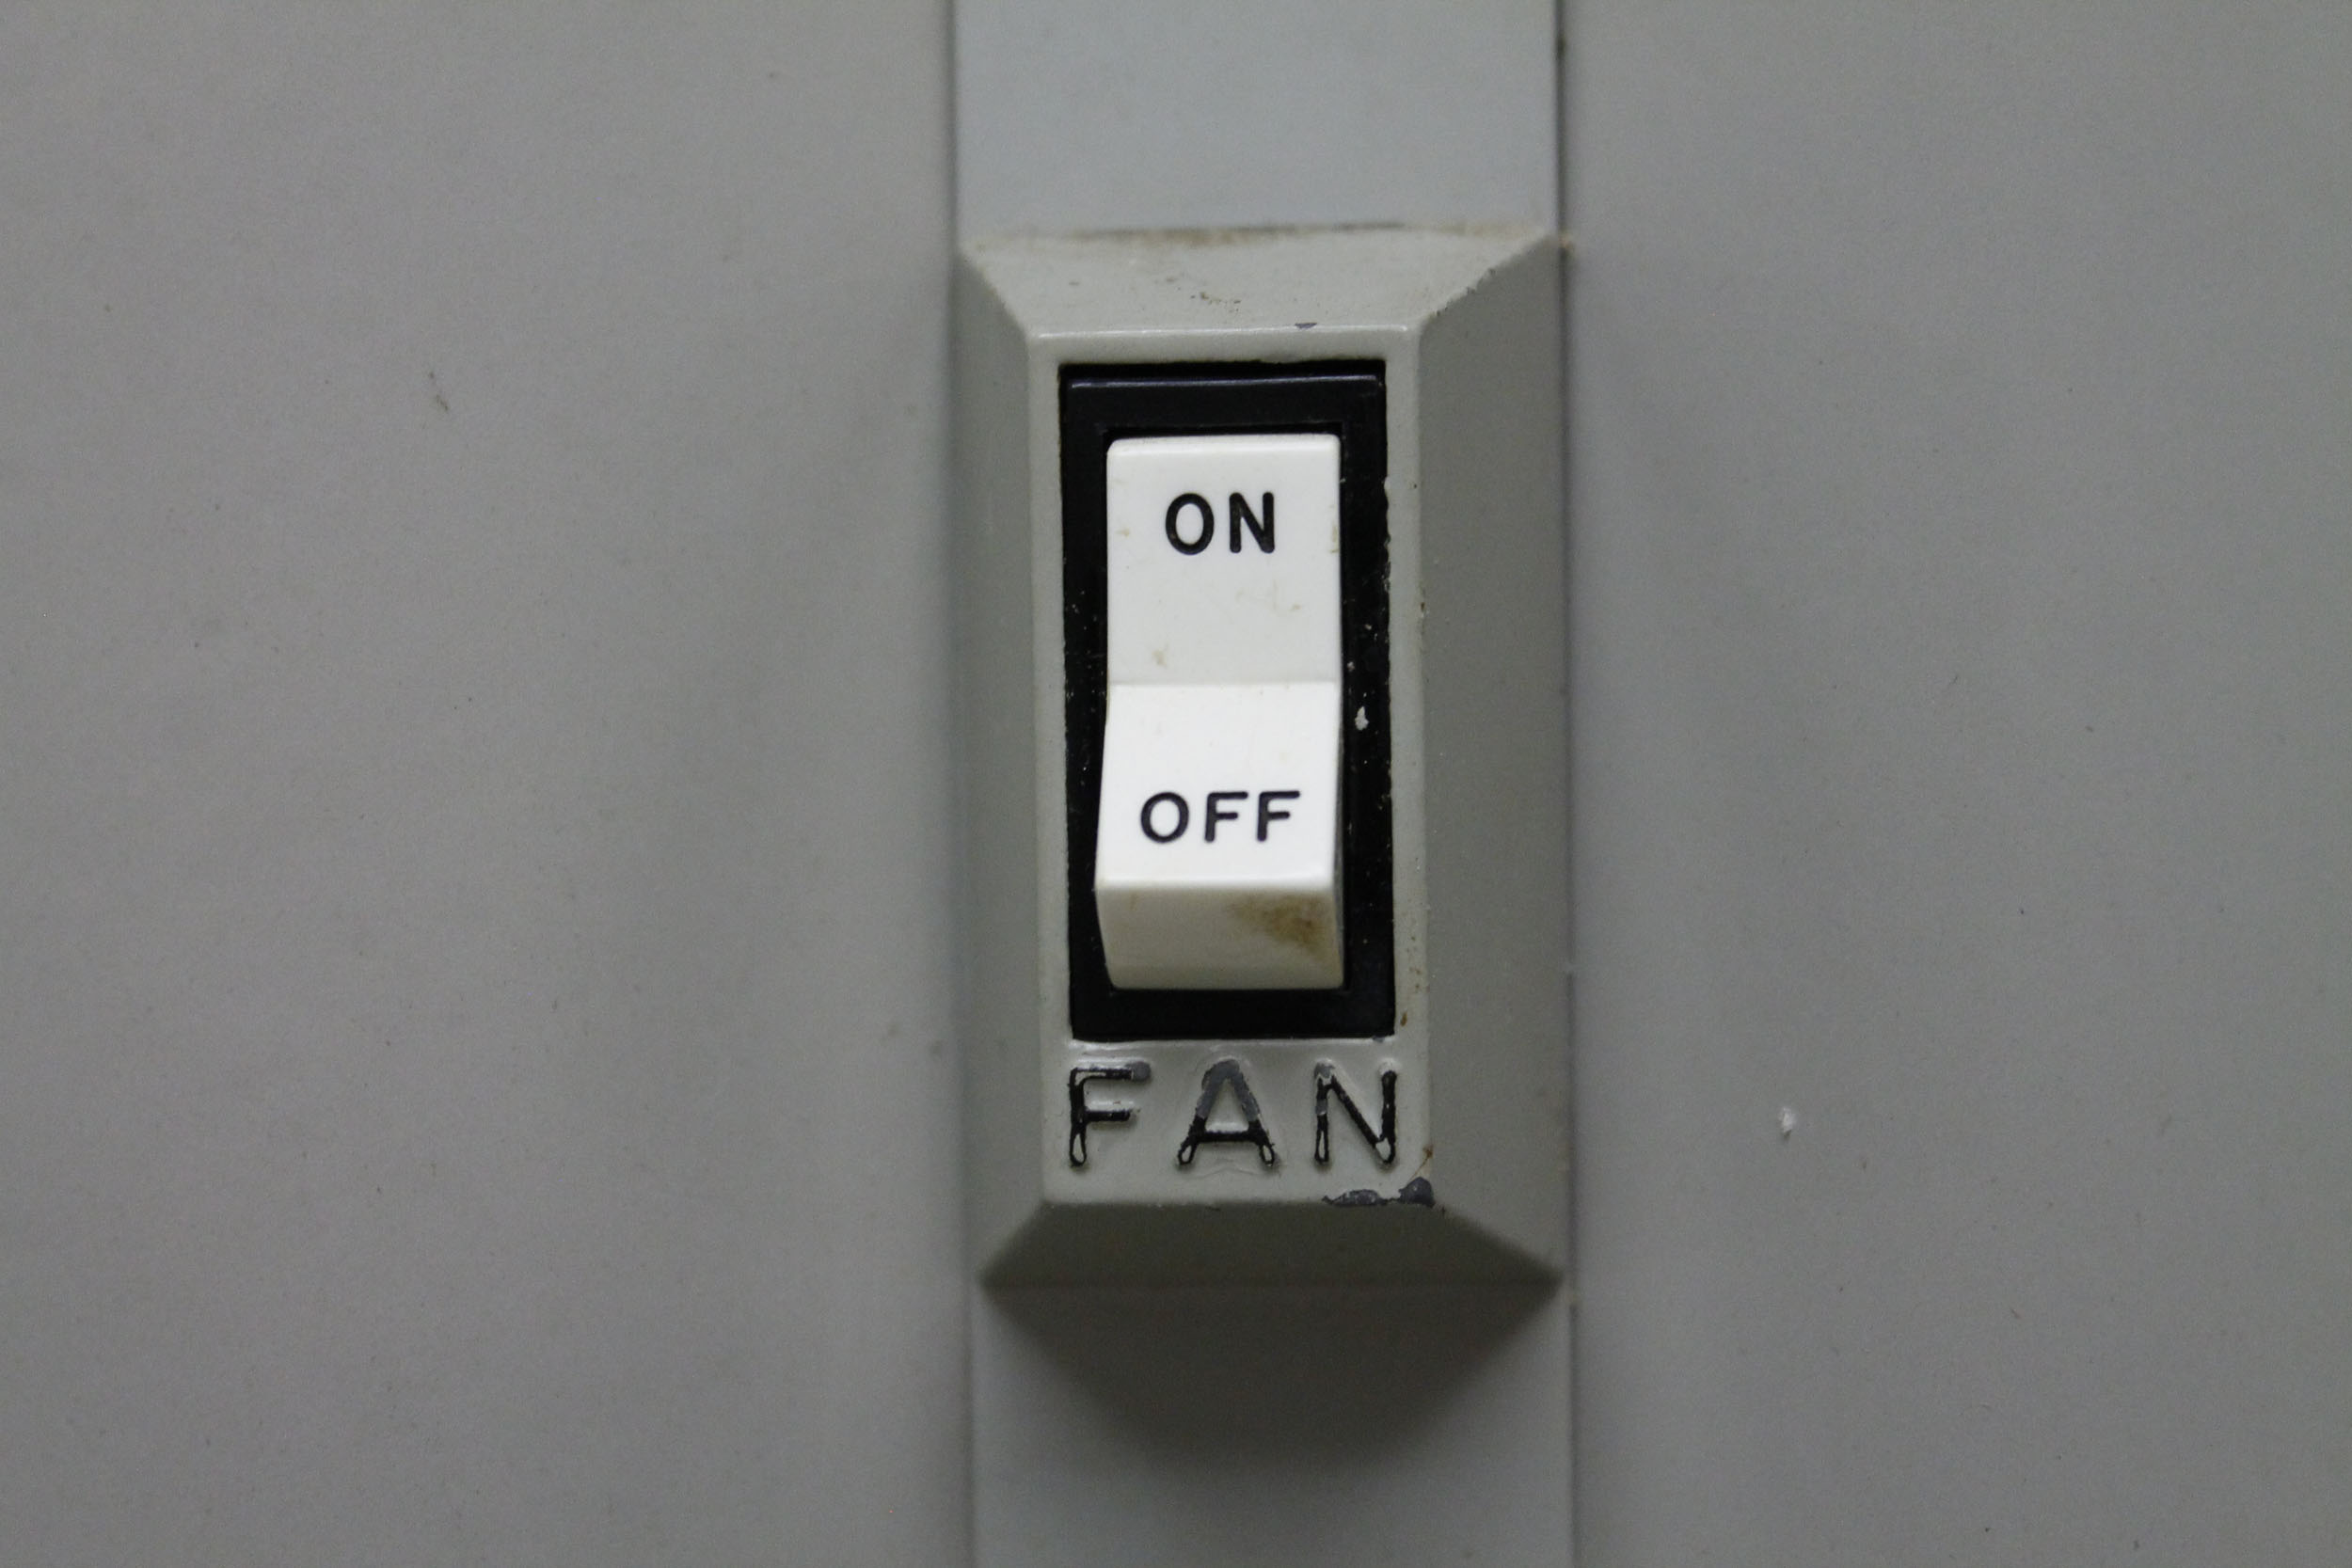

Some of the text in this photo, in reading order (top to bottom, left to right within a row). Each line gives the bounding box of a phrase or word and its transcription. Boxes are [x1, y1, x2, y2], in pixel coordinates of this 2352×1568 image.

[1165, 491, 1276, 556] ON
[1140, 790, 1301, 844] OFF
[1069, 1058, 1397, 1166] FAN
